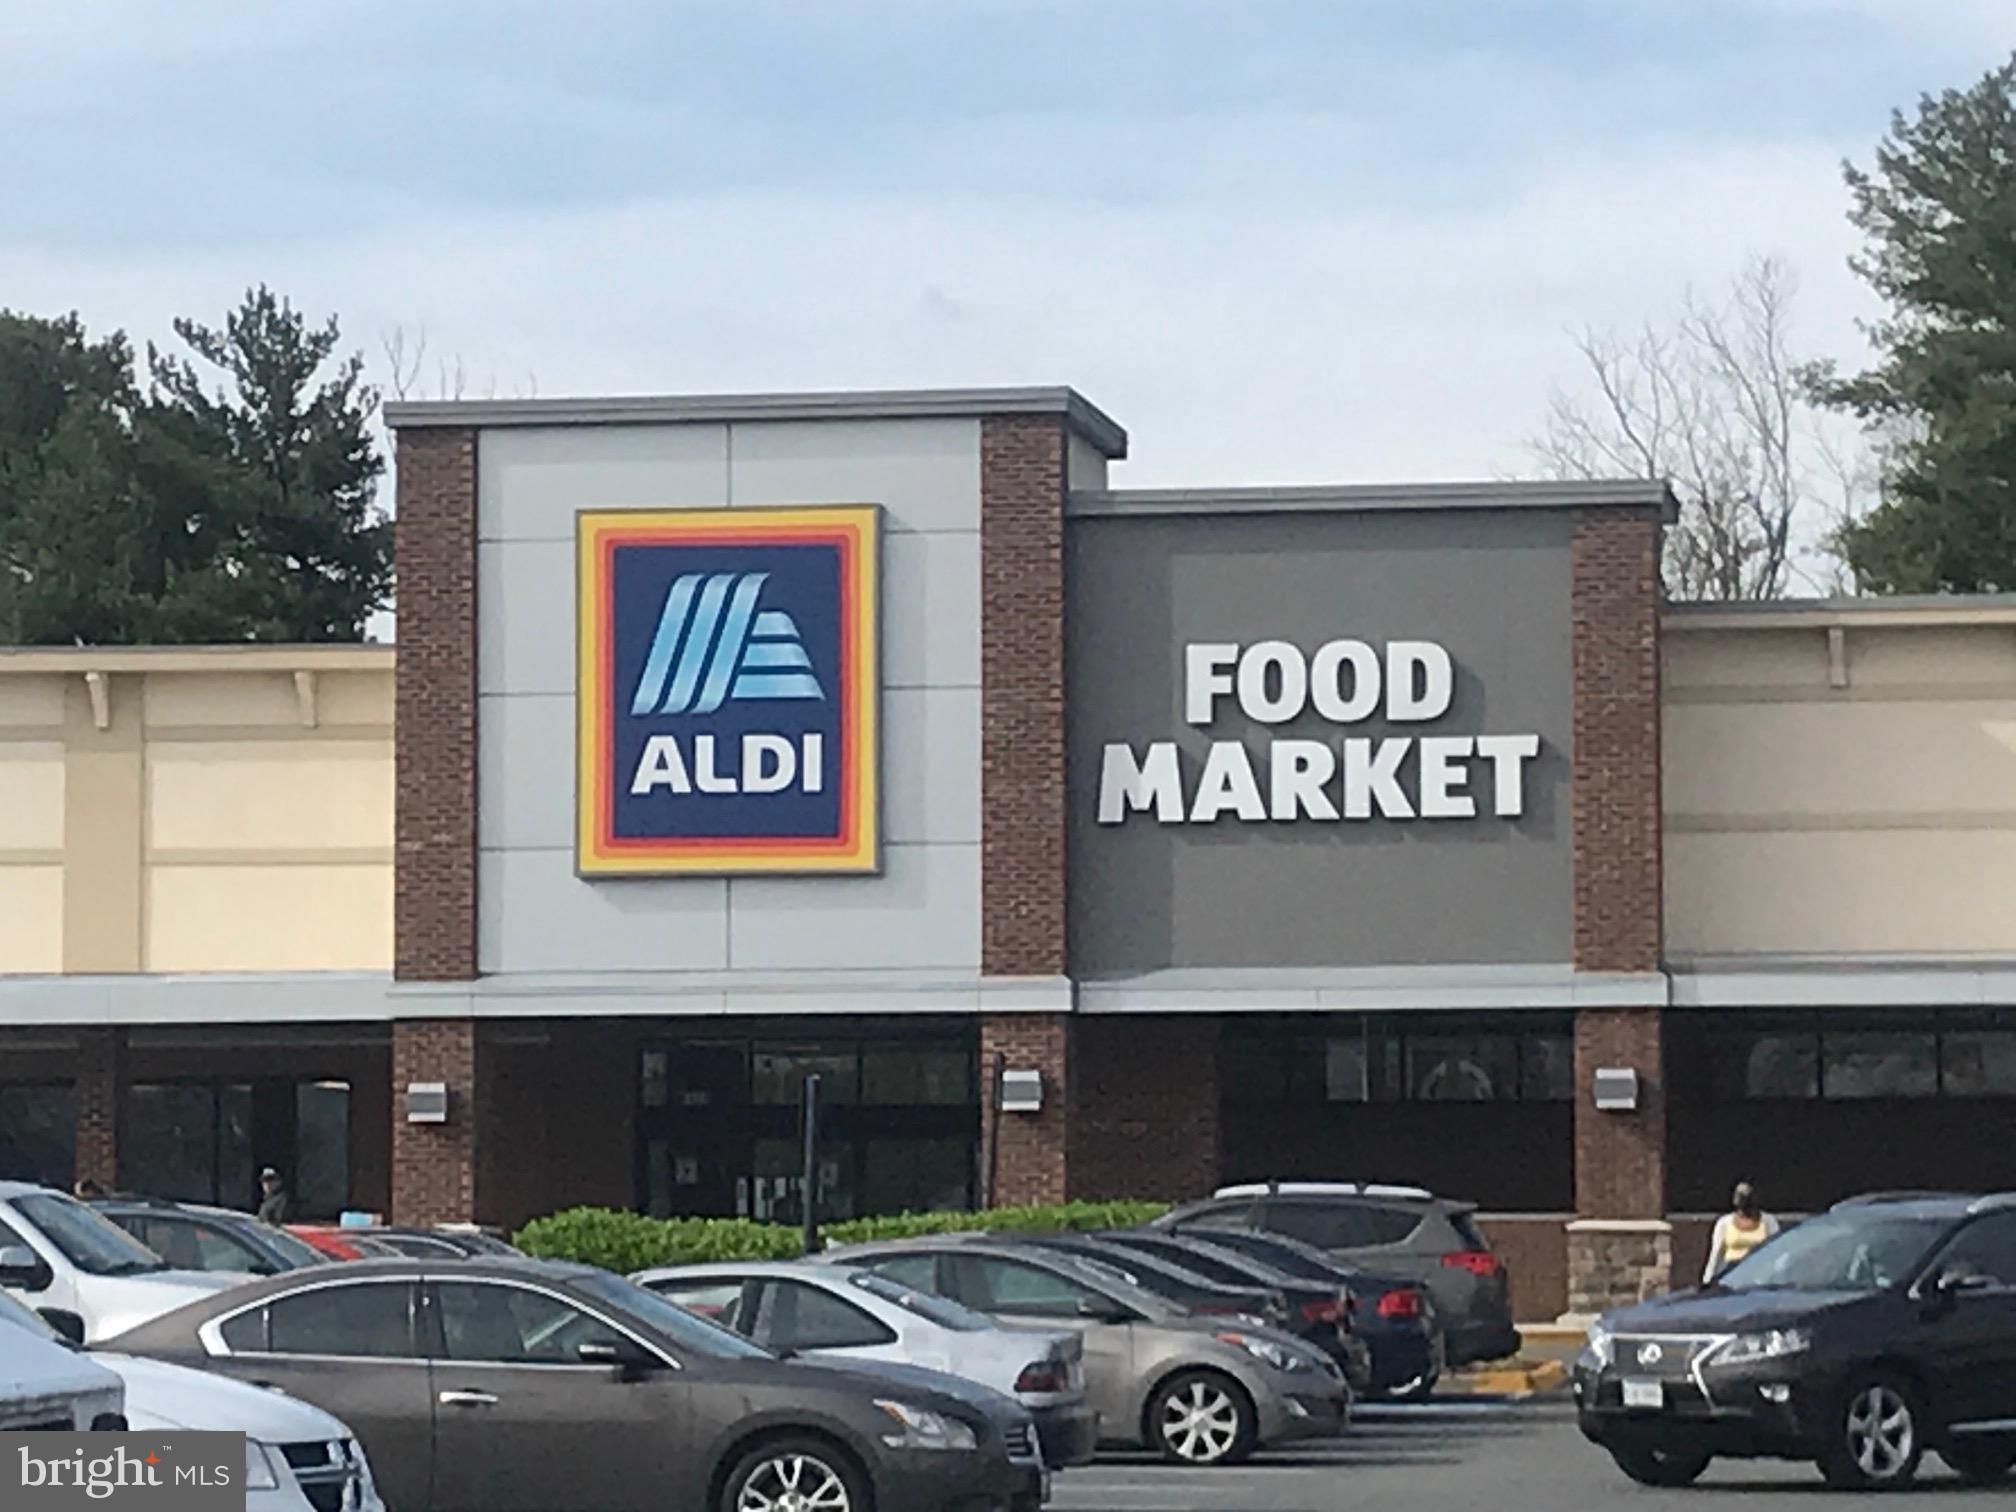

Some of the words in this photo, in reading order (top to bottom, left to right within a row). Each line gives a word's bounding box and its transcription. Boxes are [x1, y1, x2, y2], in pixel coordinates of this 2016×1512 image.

[1185, 639, 1454, 724] FOOD
[630, 733, 824, 795] ALDI
[1097, 734, 1540, 823] MARKET
